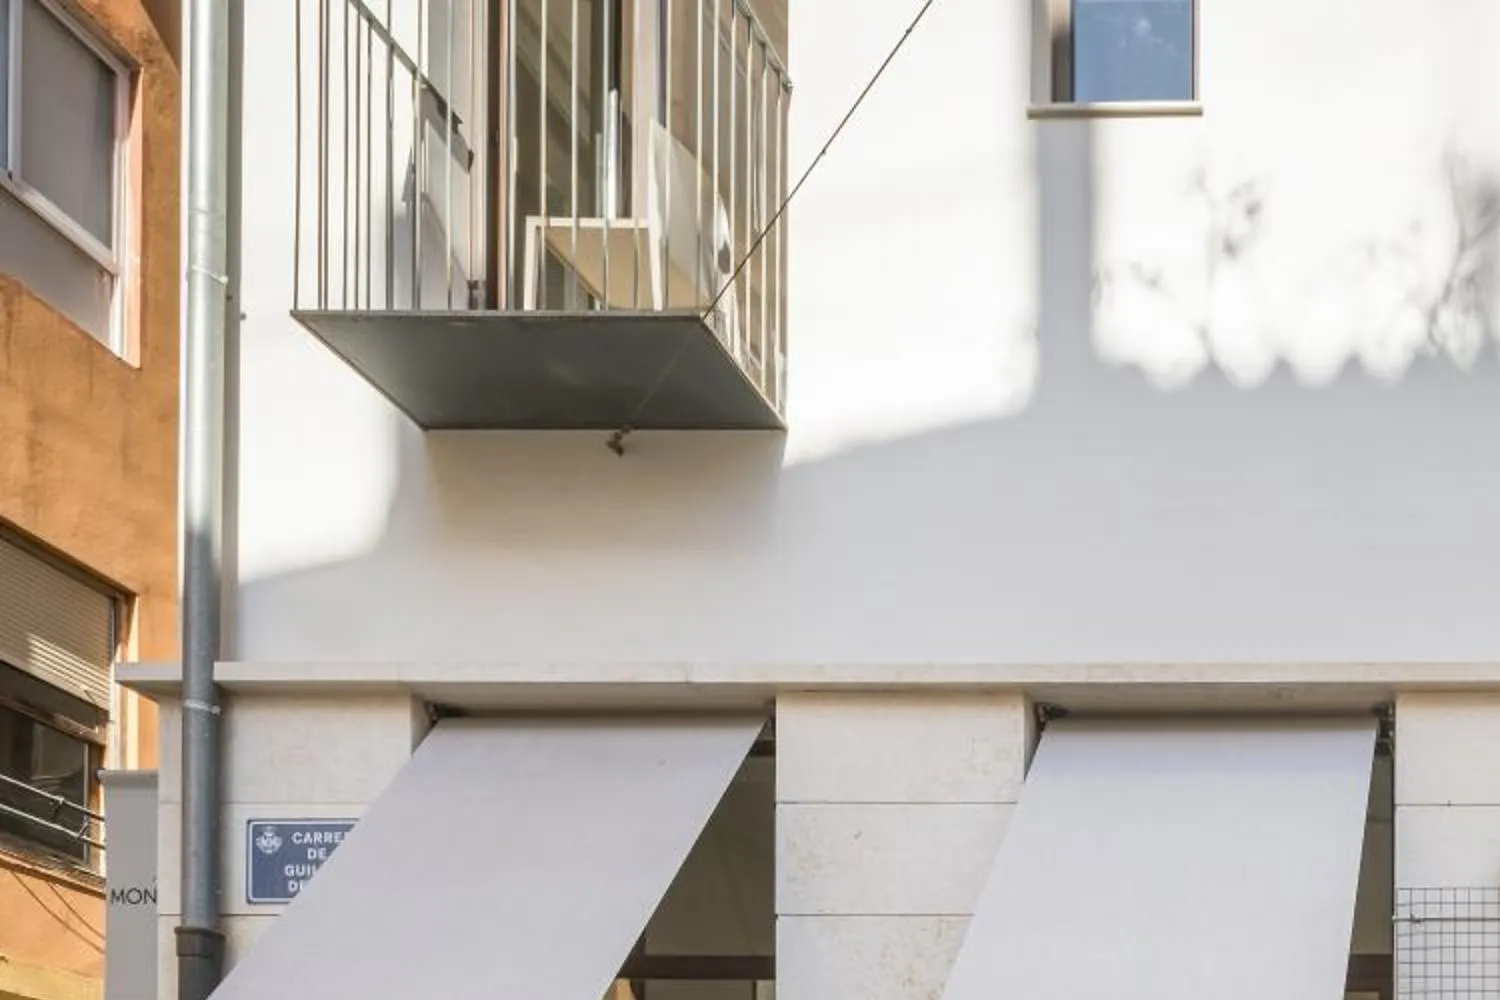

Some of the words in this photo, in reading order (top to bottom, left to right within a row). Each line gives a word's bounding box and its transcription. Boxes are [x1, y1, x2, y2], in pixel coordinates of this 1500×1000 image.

[291, 831, 345, 844] CARRE
[307, 847, 327, 860] DE
[284, 863, 315, 877] GUI
[287, 879, 303, 892] D
[110, 887, 157, 905] MON
